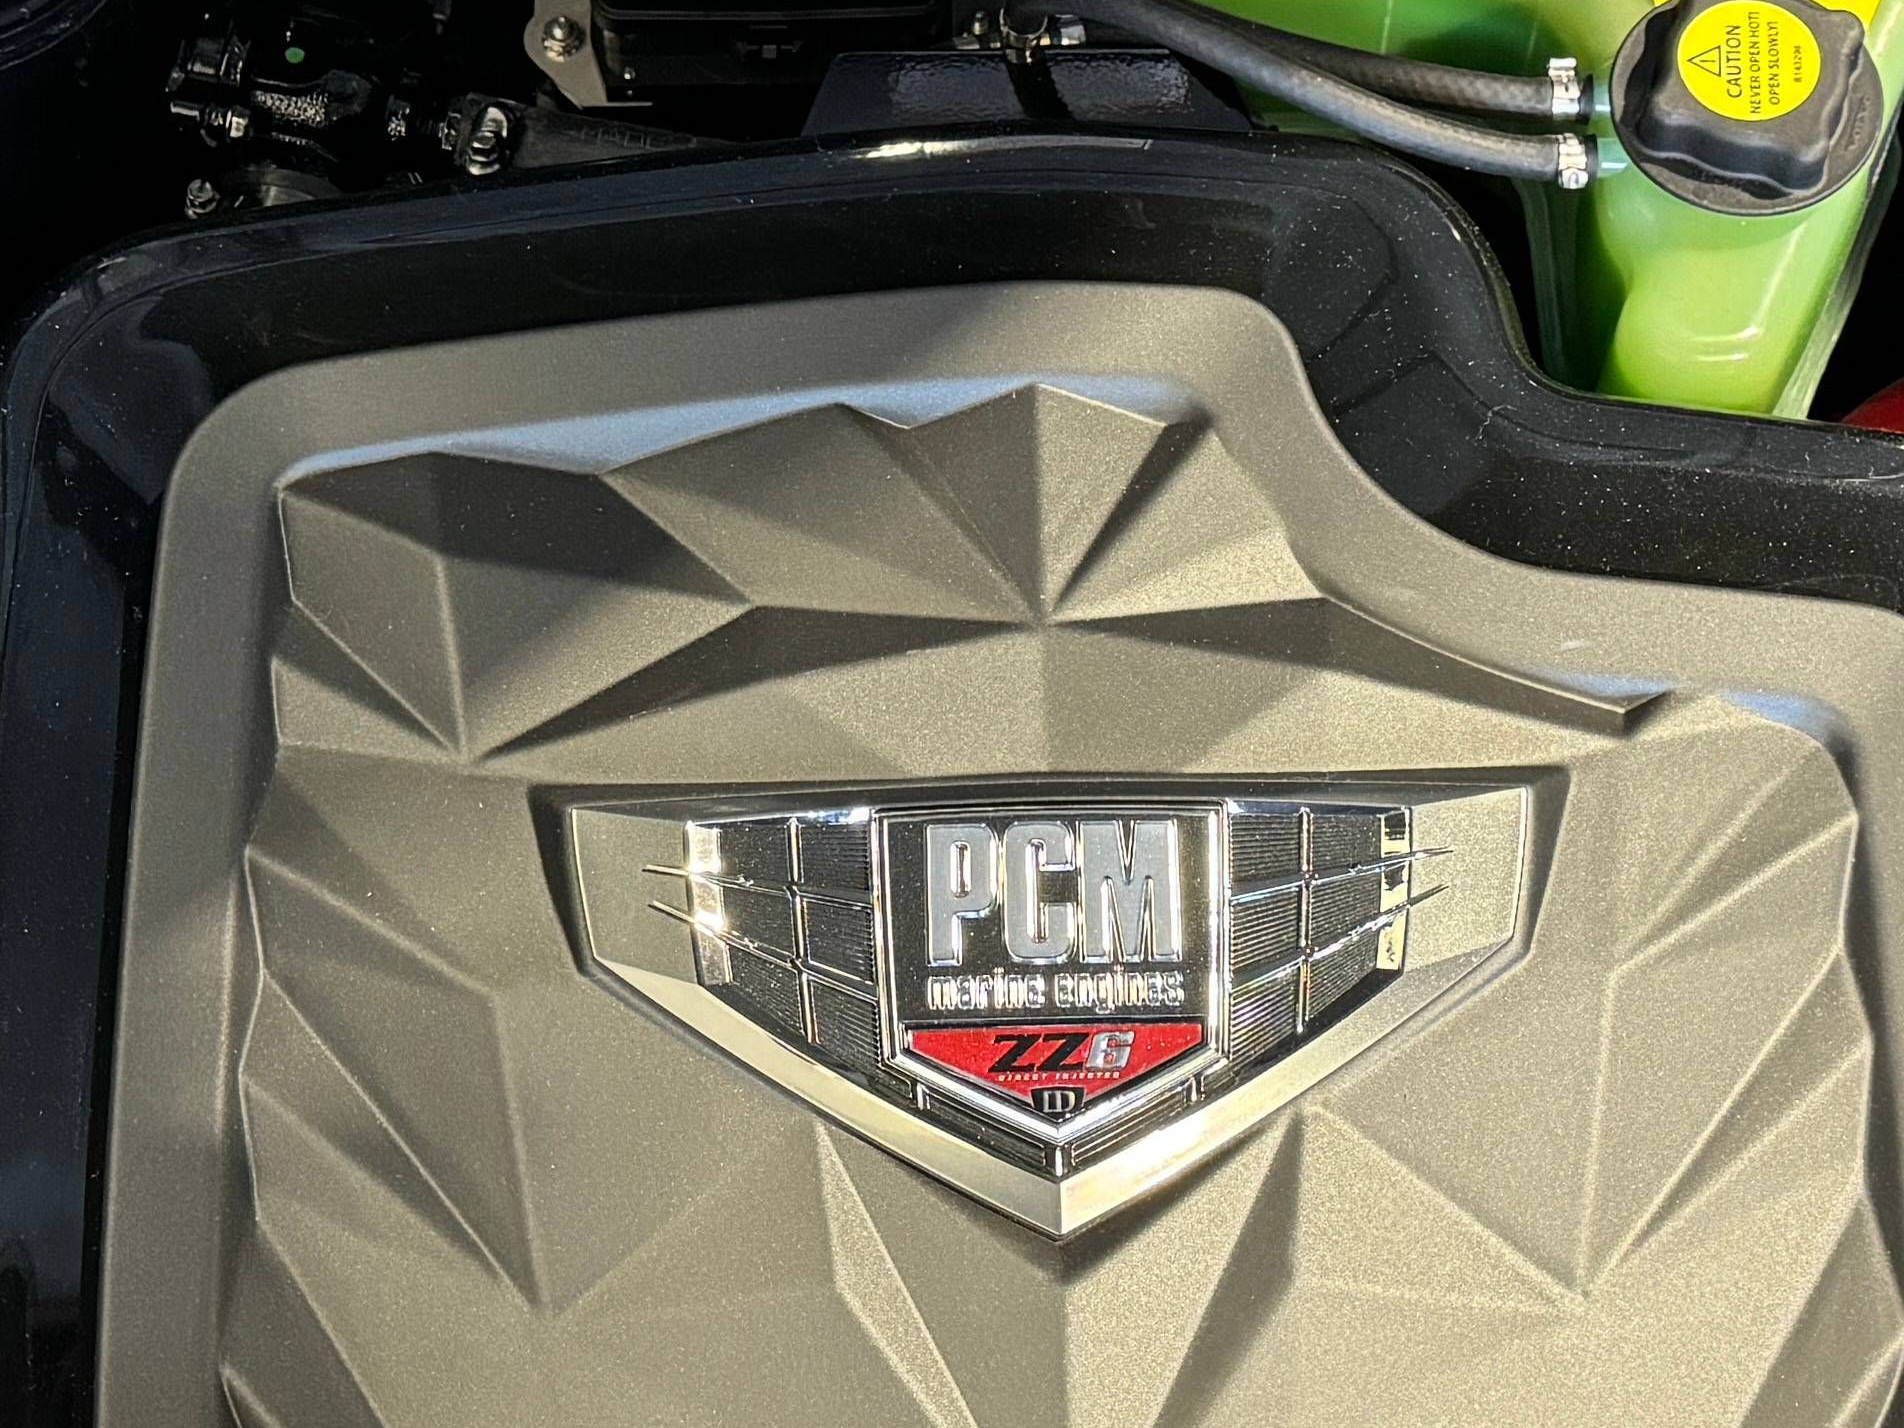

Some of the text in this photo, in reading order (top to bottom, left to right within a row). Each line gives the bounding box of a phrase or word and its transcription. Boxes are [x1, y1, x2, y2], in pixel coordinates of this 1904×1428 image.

[1726, 25, 1742, 98] CAUTION
[1748, 12, 1761, 114] NEVER OPEN HOT!
[1767, 21, 1780, 106] OPEN SLOWLY!
[925, 820, 1183, 966] PCM
[927, 965, 1185, 1014] marine engines
[988, 1031, 1135, 1073] ZZ6
